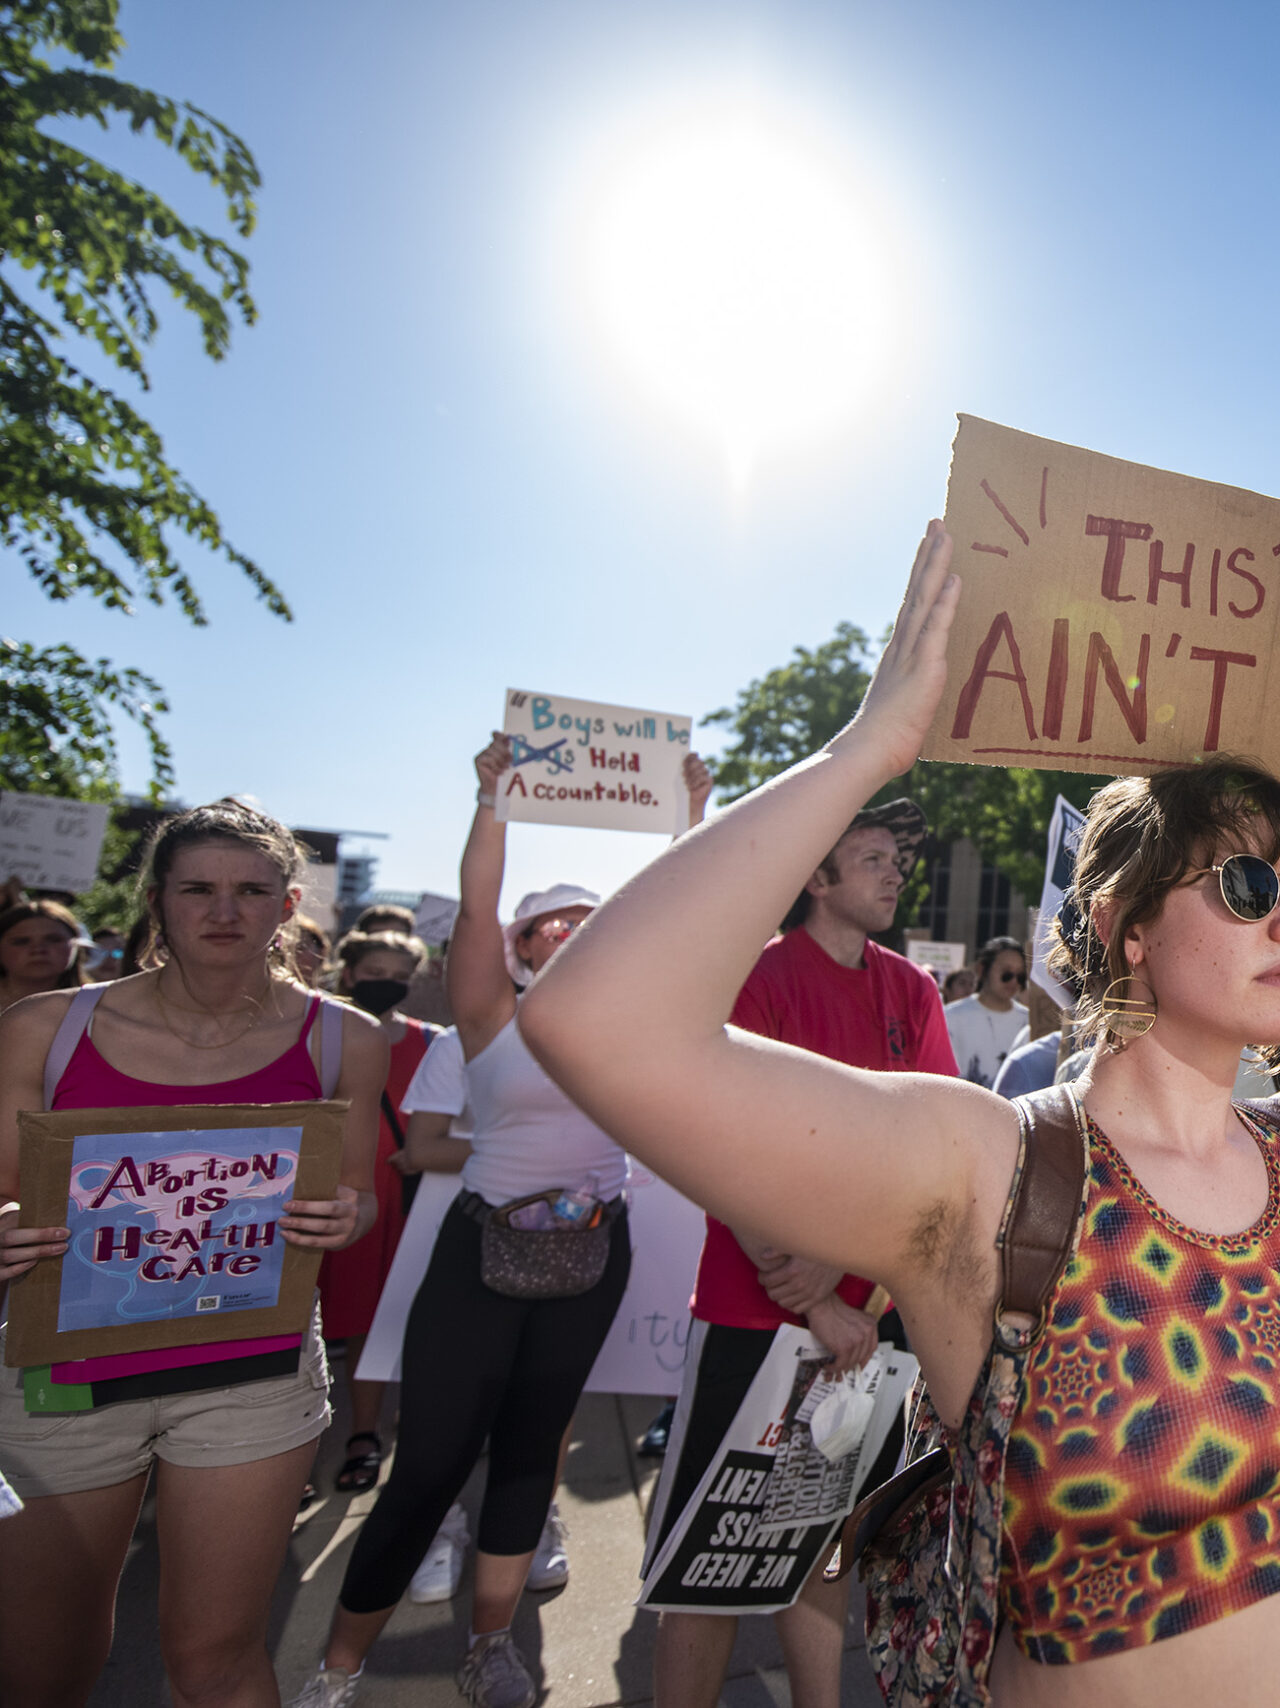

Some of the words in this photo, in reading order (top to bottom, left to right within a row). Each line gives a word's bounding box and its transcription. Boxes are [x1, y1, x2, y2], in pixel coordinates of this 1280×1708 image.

[950, 611, 1257, 752] AIN'T
[613, 717, 656, 740] will
[667, 720, 690, 745] be
[590, 747, 640, 774] Held
[681, 1552, 754, 1588] NEED
[750, 1554, 797, 1588] WE
